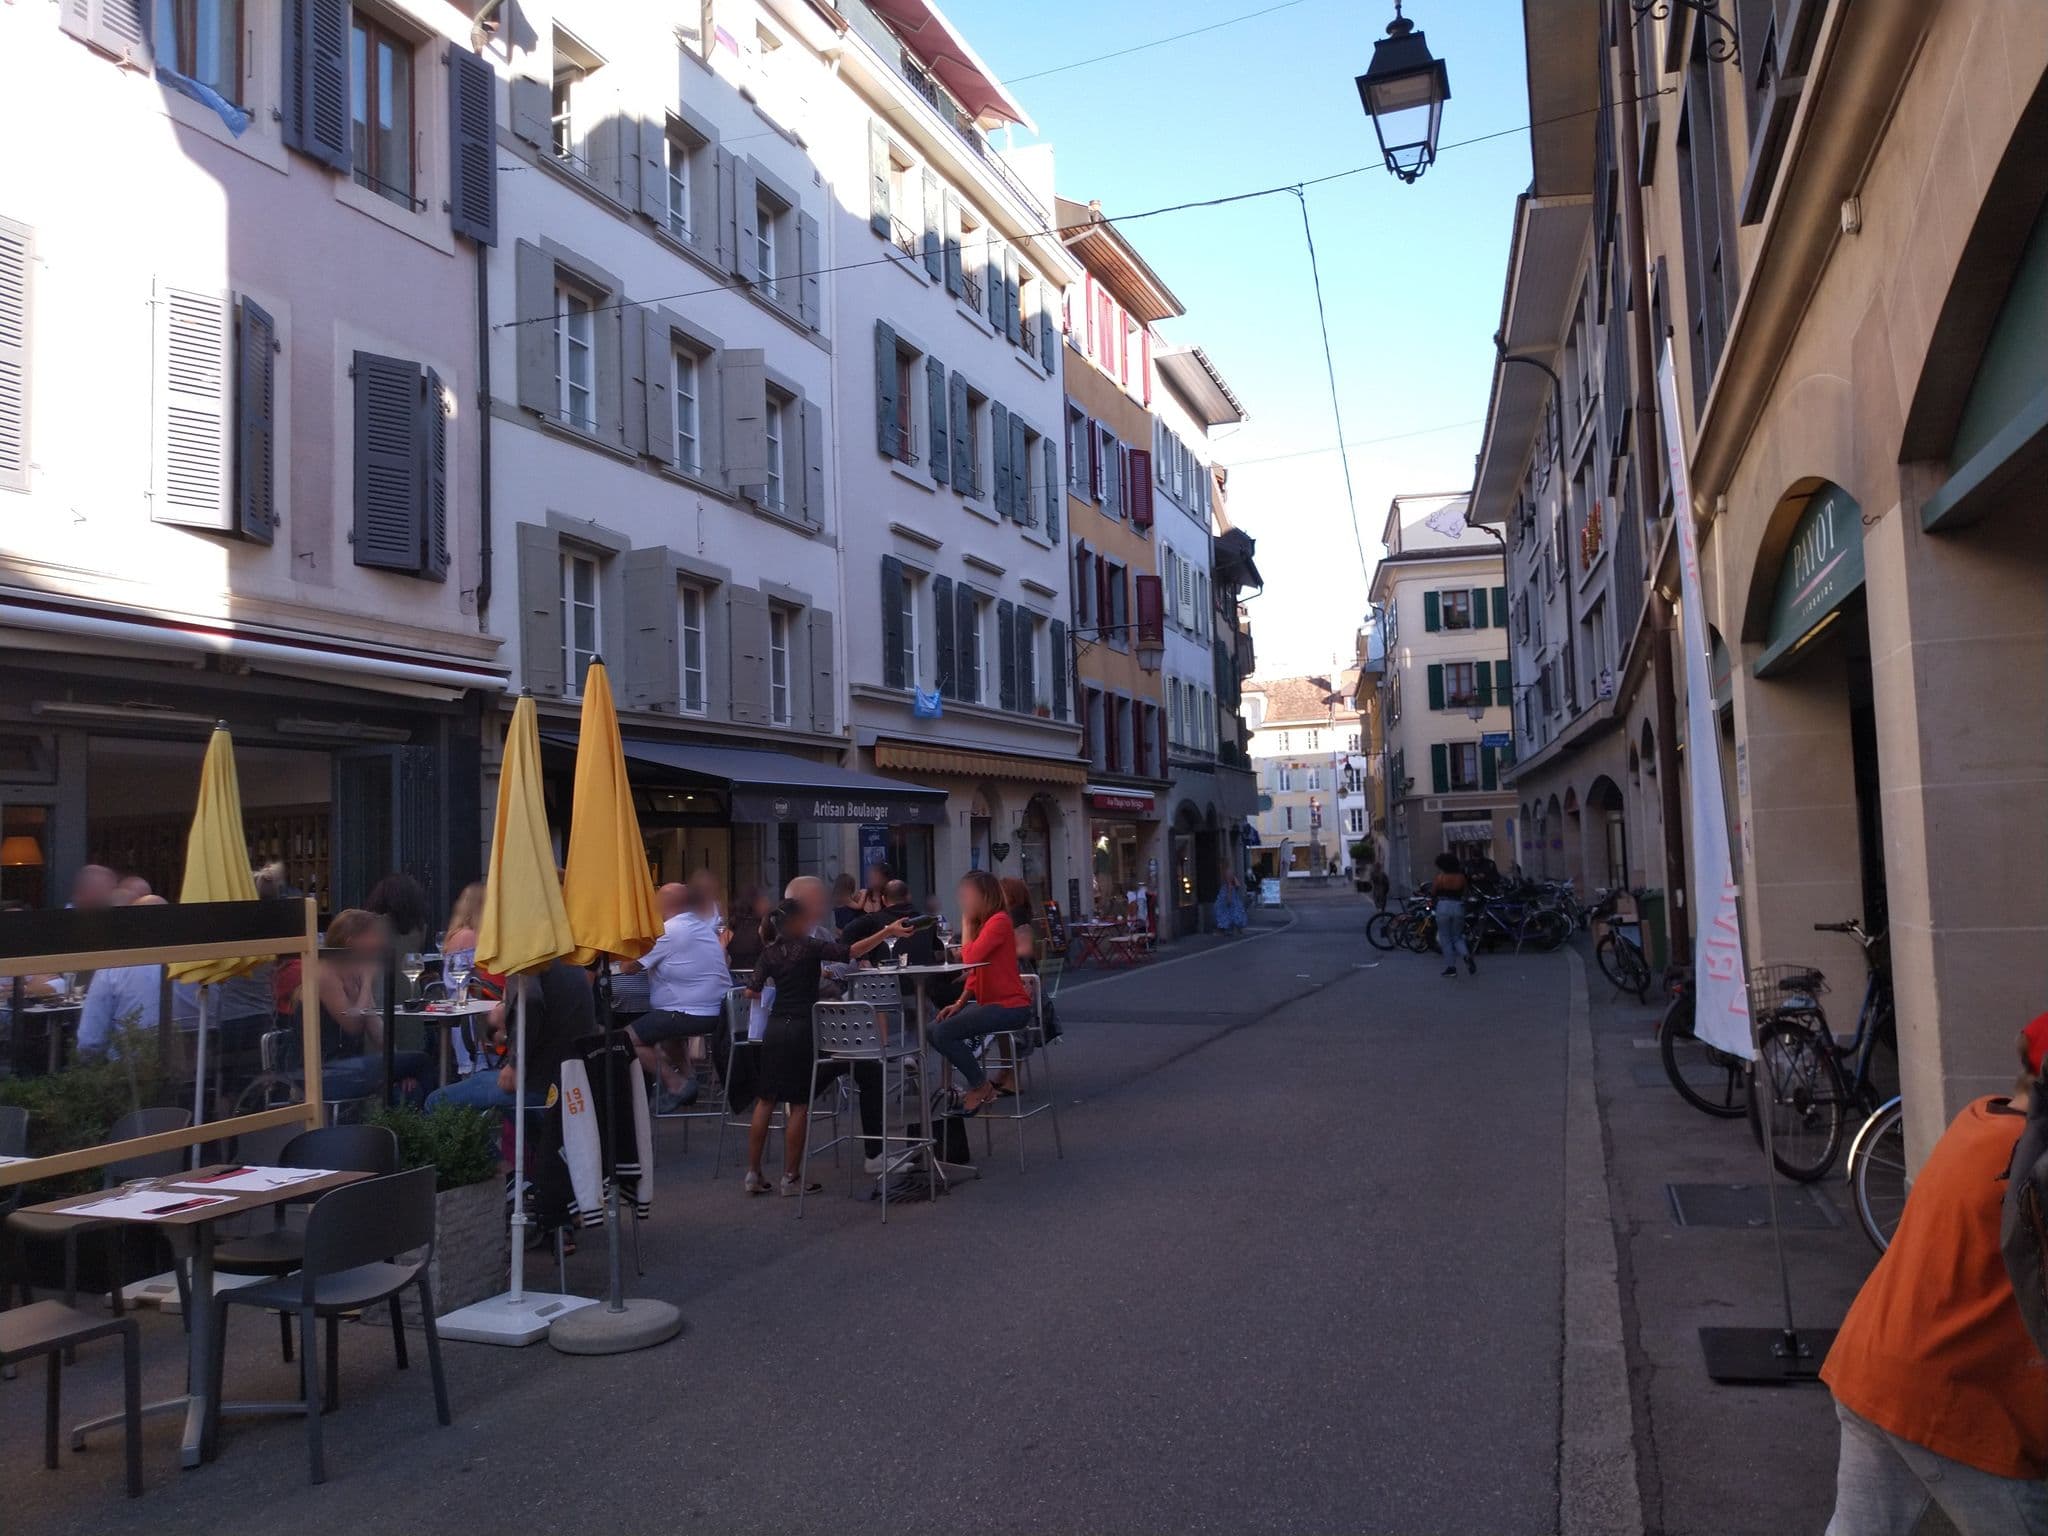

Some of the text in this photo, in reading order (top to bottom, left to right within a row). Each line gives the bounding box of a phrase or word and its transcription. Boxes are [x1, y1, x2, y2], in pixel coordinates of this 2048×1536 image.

[1793, 499, 1835, 589] PAYOT
[813, 800, 845, 817] Artisan
[847, 801, 889, 821] Boulanger
